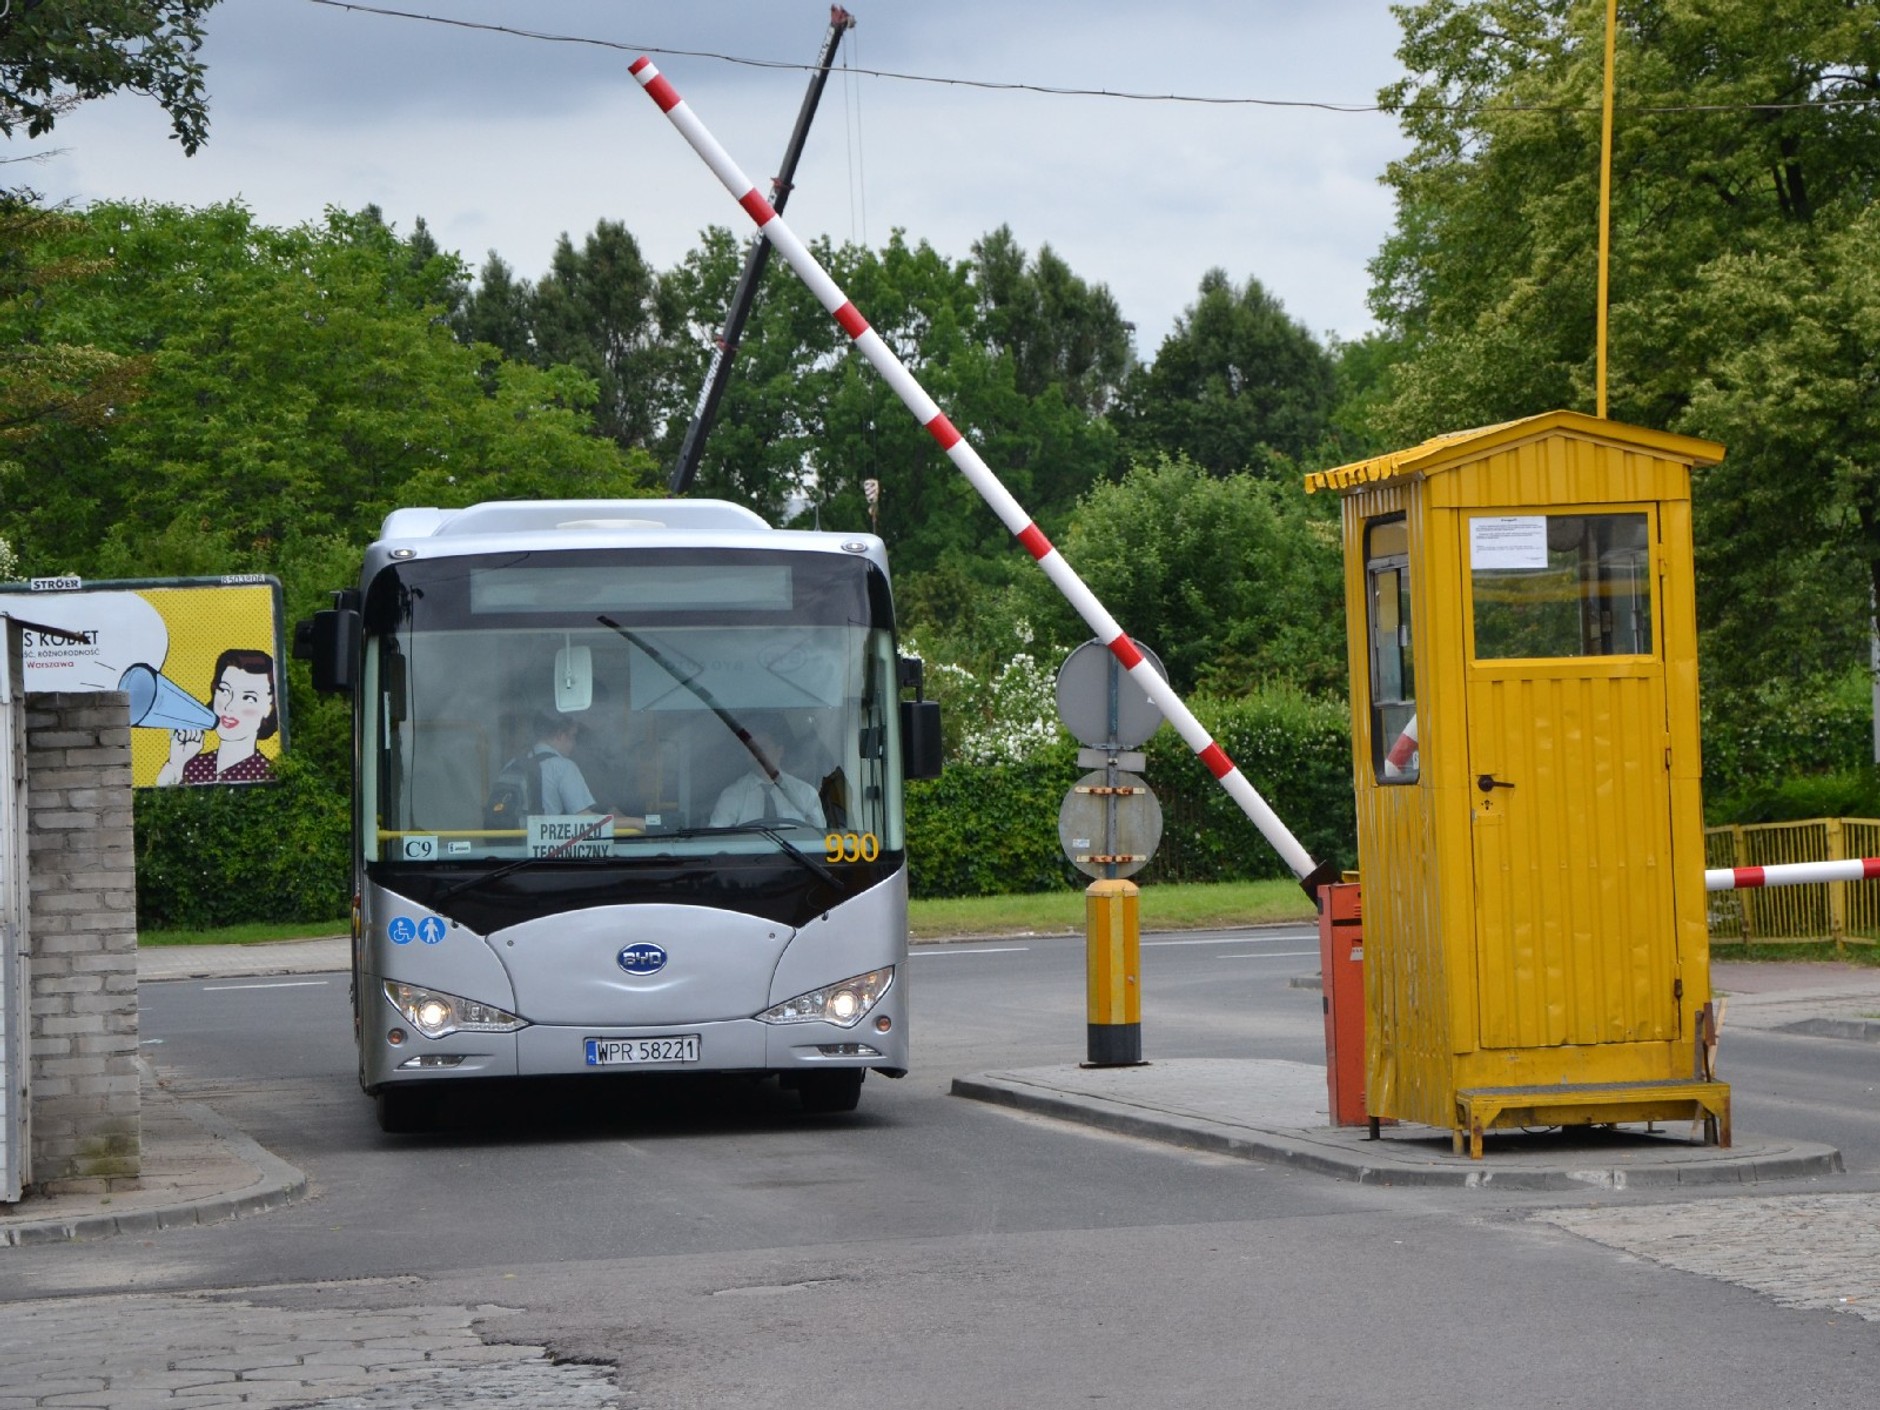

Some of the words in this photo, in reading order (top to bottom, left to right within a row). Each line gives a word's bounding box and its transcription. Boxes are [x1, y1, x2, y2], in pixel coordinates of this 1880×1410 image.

[33, 578, 79, 590] STRÖER
[27, 661, 75, 669] Warszawa
[405, 840, 432, 858] C9
[825, 832, 879, 863] 930
[623, 951, 662, 966] BYD
[597, 1043, 633, 1061] WPR
[639, 1040, 694, 1060] 58221
